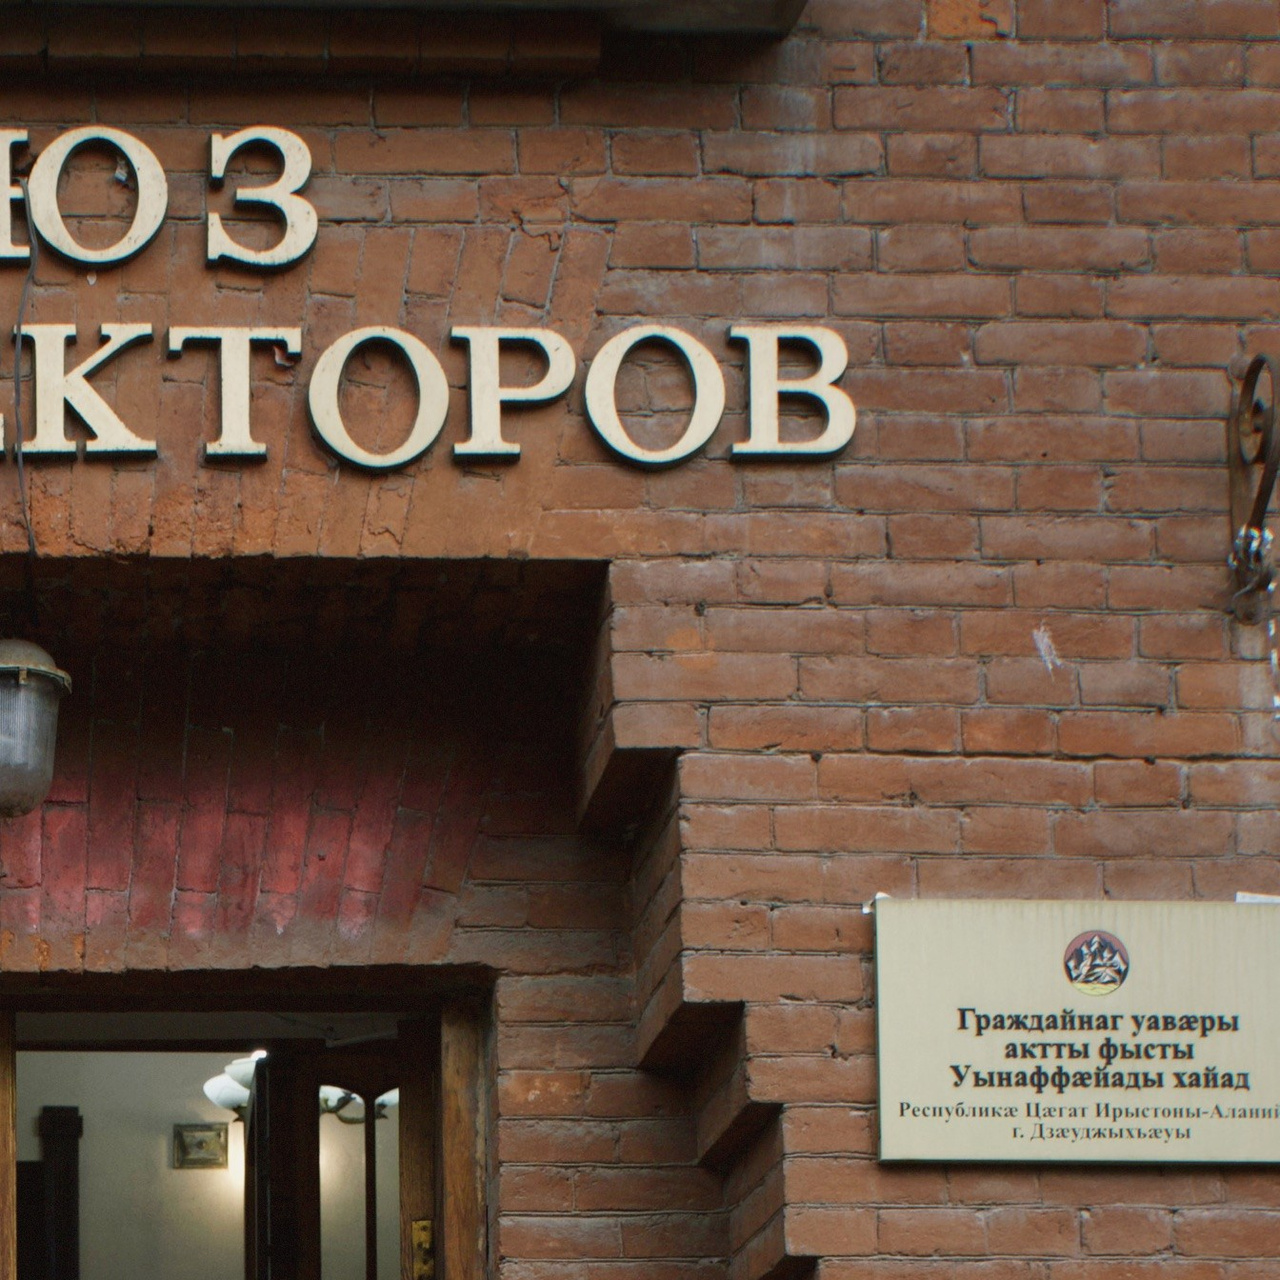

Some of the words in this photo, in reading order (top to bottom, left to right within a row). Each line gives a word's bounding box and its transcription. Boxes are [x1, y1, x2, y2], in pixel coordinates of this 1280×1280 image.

[957, 1008, 1124, 1037] Граждайнаг
[1004, 1041, 1090, 1060] актты
[1098, 1037, 1195, 1066] фысты
[1172, 1066, 1251, 1091] хайад
[1012, 1126, 1025, 1139] г.
